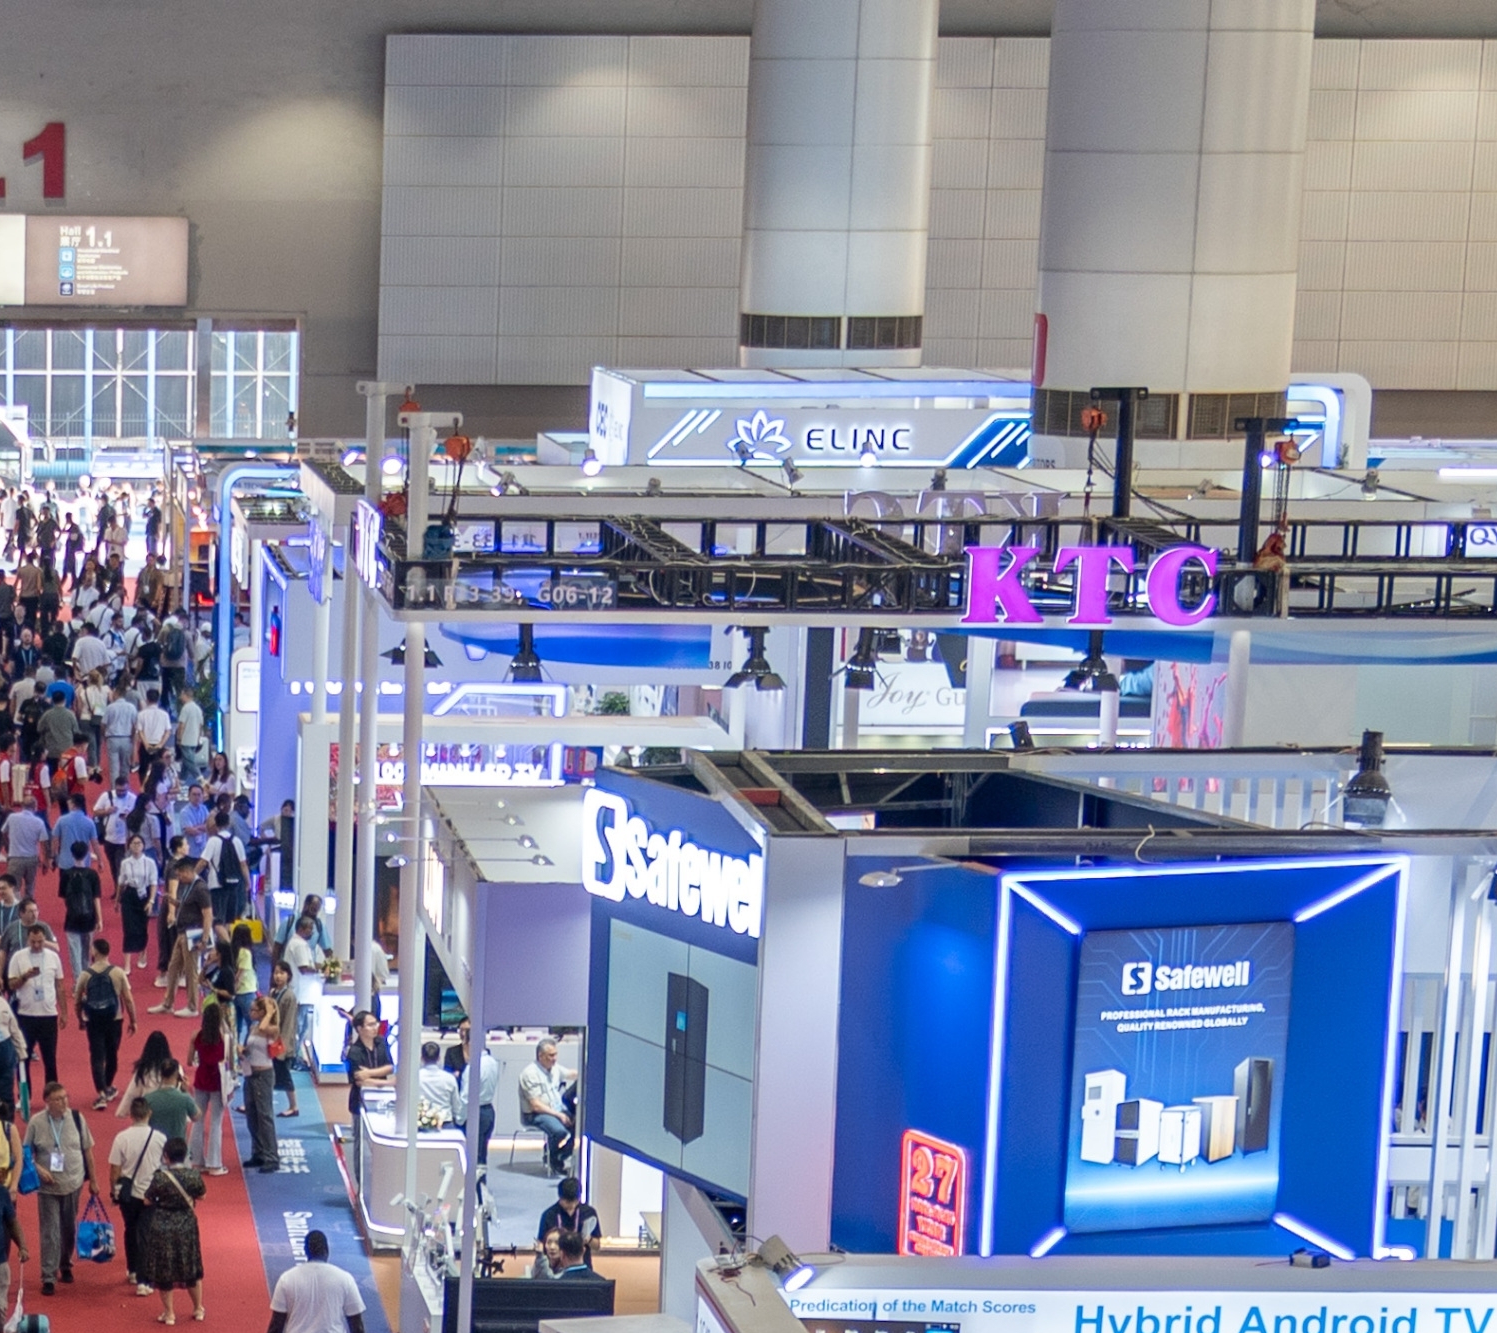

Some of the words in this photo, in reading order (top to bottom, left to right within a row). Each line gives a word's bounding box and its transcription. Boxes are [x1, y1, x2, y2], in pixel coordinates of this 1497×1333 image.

[60, 226, 82, 236] Hall
[86, 226, 113, 247] 1.1
[807, 428, 911, 451] ELINC
[538, 585, 614, 606] G06-12
[960, 545, 1220, 626] KTC
[1154, 960, 1251, 992] Safewell
[1100, 1008, 1167, 1022] PROFESSIONAL
[1166, 1007, 1191, 1018] RACK
[1191, 1003, 1266, 1017] MANUFACTURING,
[1116, 1022, 1154, 1033] QUALITY
[1154, 1019, 1203, 1031] RENOWNED
[1203, 1016, 1249, 1029] GLOBALLY
[910, 1146, 958, 1204] 27
[789, 1299, 878, 1315] Predication
[882, 1299, 900, 1312] of
[902, 1299, 927, 1312] the
[930, 1299, 978, 1313] Match
[982, 1300, 1037, 1314] Scores
